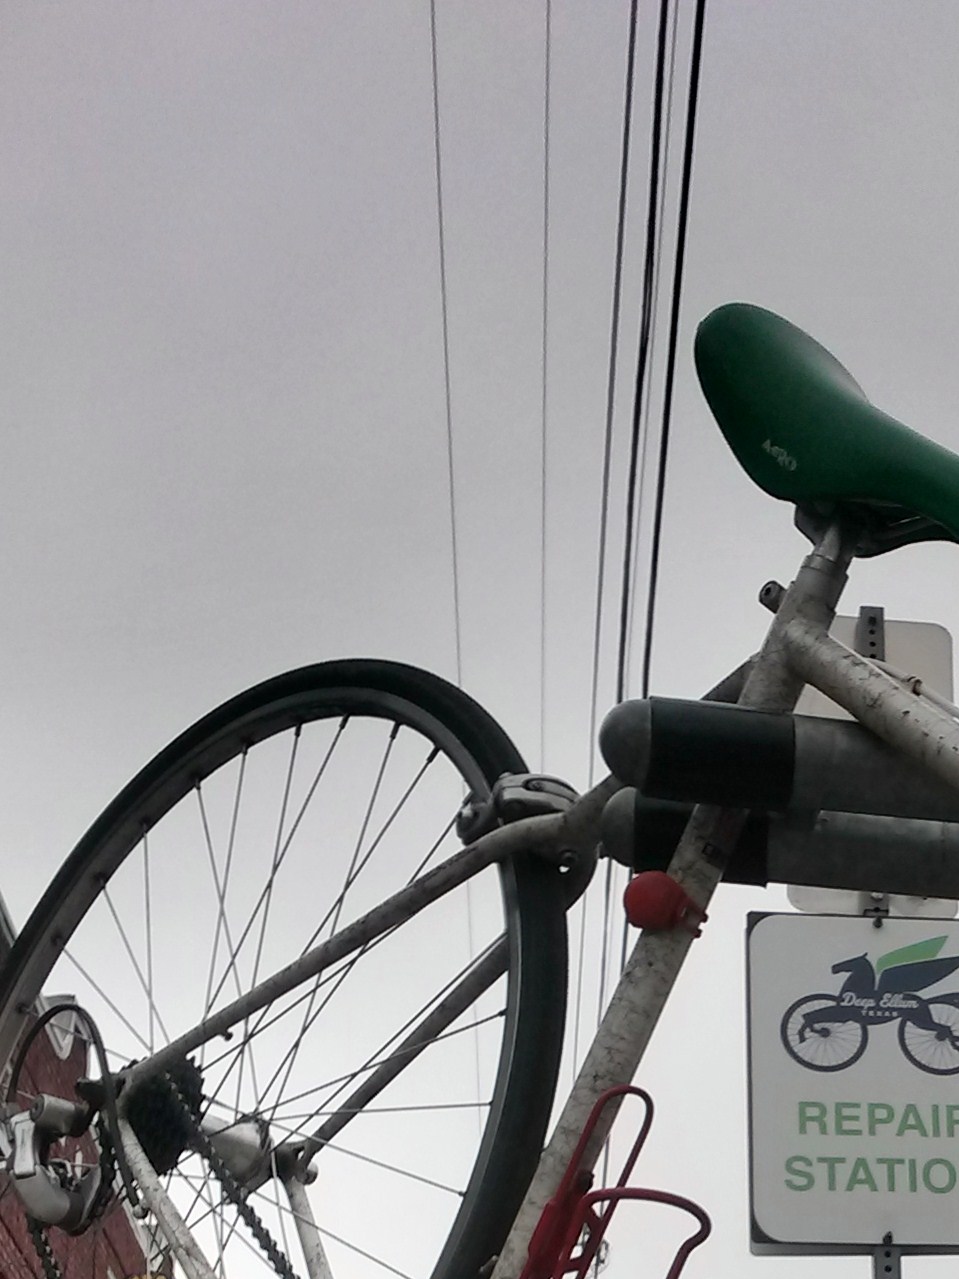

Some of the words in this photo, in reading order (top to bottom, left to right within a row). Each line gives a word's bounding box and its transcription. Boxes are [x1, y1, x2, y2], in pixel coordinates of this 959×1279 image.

[840, 991, 877, 1010] Deep
[880, 993, 919, 1009] Ellum
[861, 1010, 899, 1018] TEXAS
